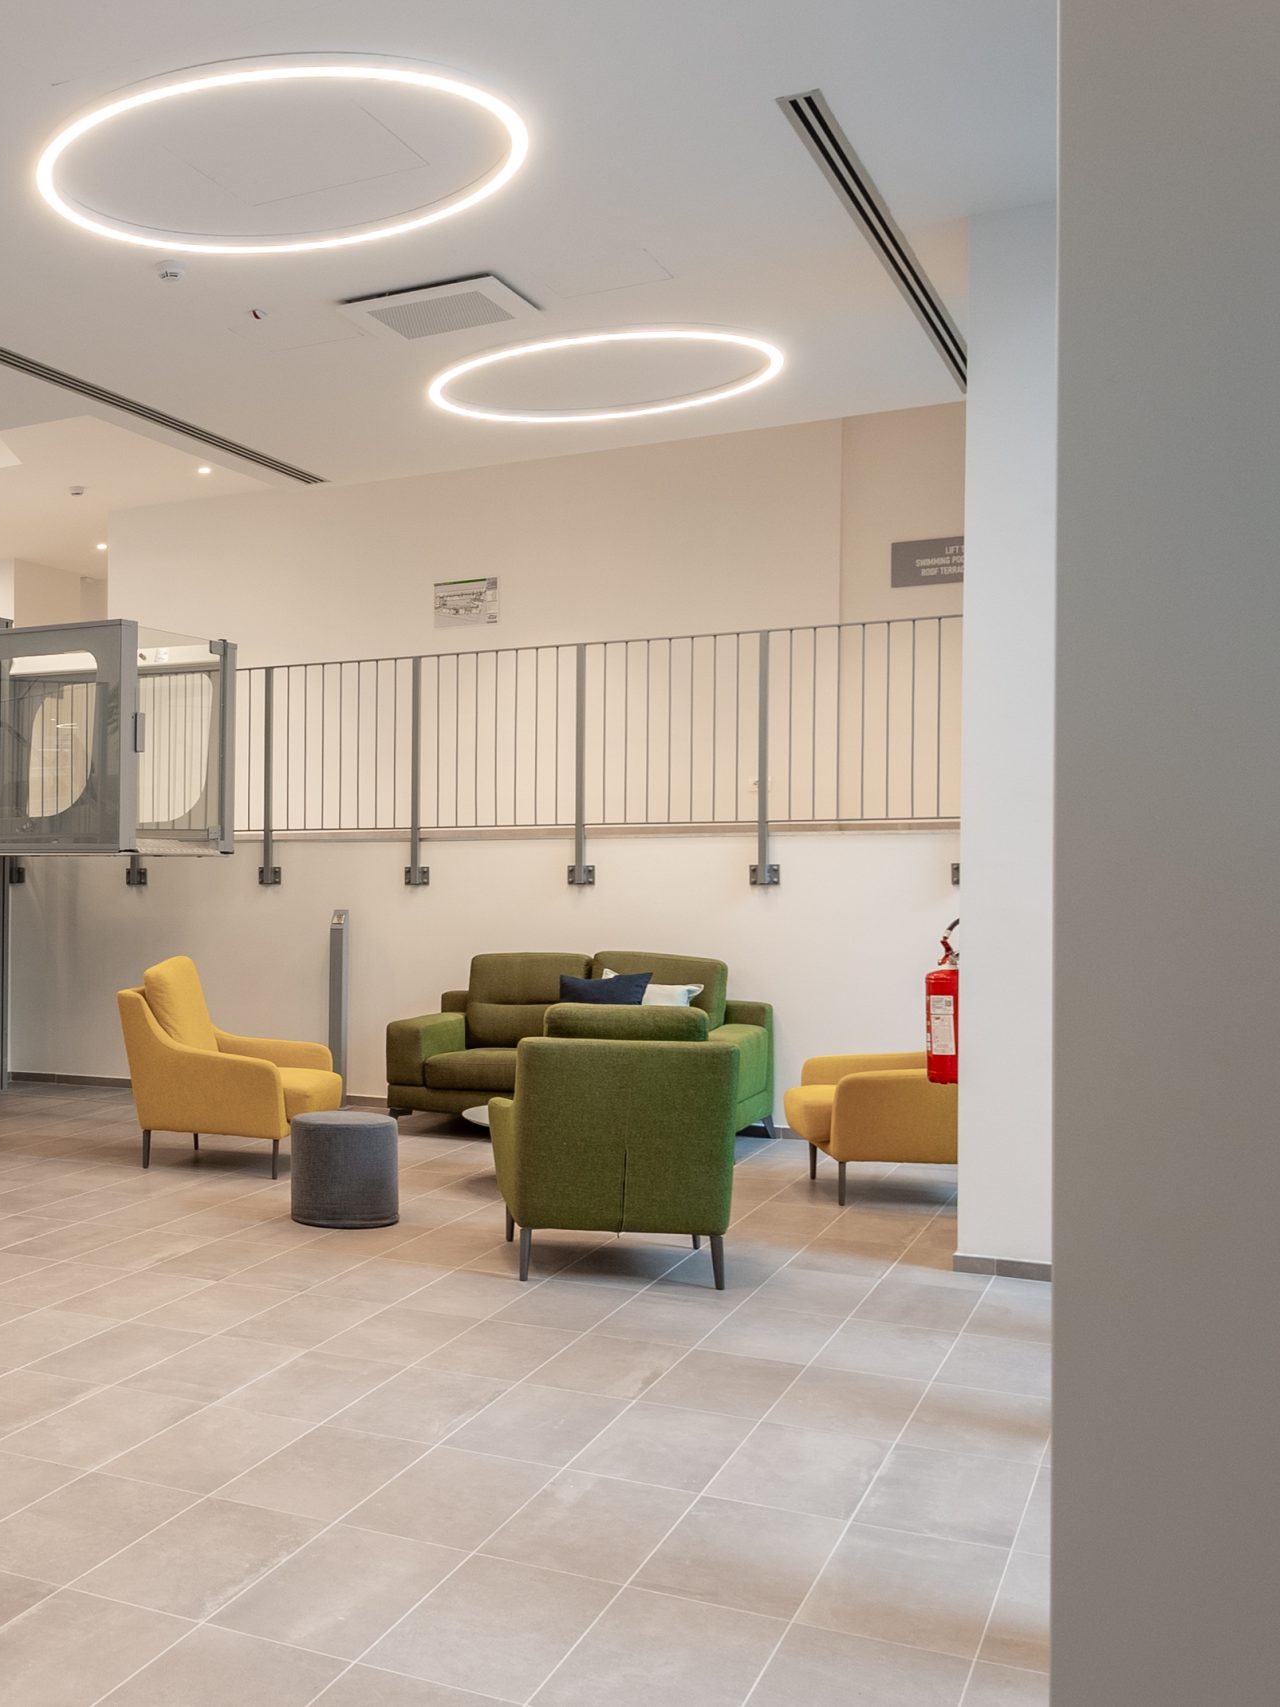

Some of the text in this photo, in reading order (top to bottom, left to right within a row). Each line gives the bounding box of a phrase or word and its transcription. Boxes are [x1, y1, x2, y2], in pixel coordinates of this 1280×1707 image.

[945, 546, 959, 555] LIFT
[915, 556, 950, 567] SWIMMING
[921, 568, 938, 576] ROOF
